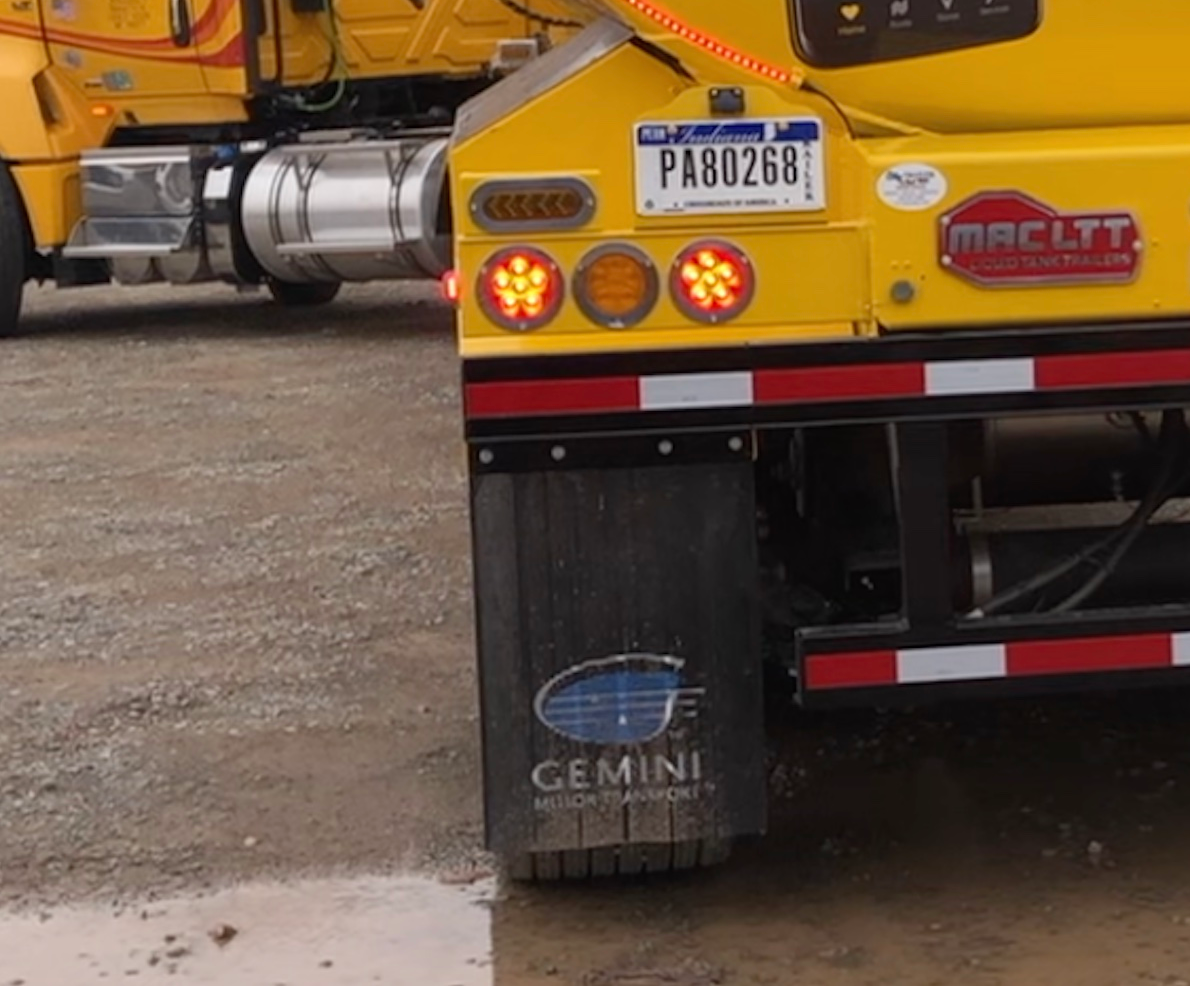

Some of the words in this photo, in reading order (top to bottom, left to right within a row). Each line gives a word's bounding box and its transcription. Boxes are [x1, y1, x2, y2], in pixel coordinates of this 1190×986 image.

[659, 145, 799, 190] PA80268
[950, 220, 1046, 254] MAC
[1051, 216, 1133, 250] LTT
[531, 752, 701, 791] GEMINI
